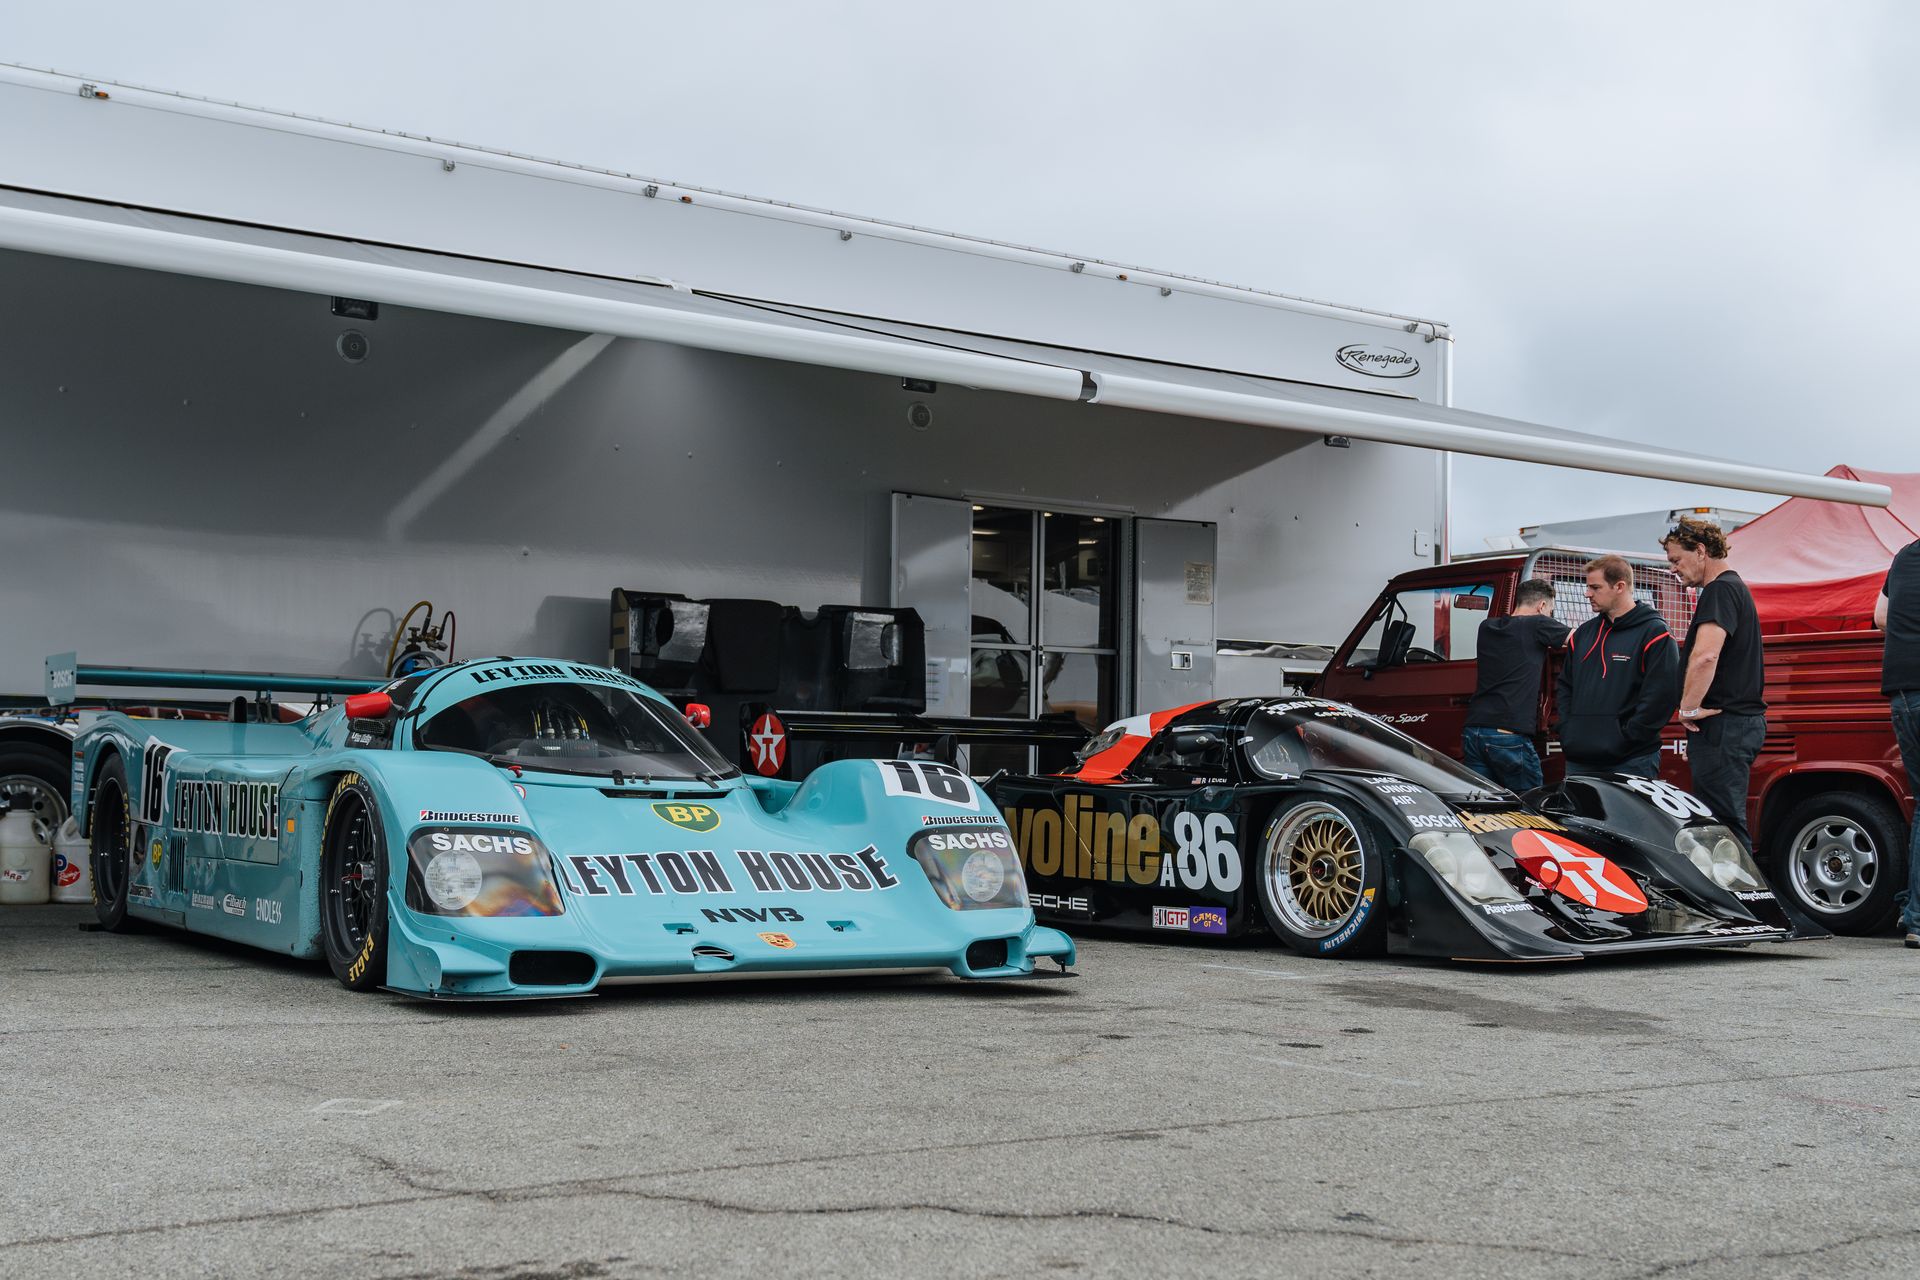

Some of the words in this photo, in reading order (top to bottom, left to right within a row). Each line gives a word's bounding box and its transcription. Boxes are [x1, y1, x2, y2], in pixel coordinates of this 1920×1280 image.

[1343, 349, 1413, 369] Renegade
[470, 664, 565, 684] LEYTON
[567, 664, 647, 692] HOUSE
[512, 674, 569, 682] PORSCHE
[1395, 713, 1429, 724] Sport
[143, 742, 173, 824] 16
[881, 760, 971, 804] 16
[1362, 776, 1401, 785] LAKE
[1376, 785, 1423, 794] UNION
[1392, 795, 1417, 806] AIR
[1626, 779, 1713, 819] 86
[172, 779, 223, 835] LEYTON
[227, 781, 280, 842] HOUSE
[420, 810, 520, 824] BRIDGESTONE
[664, 805, 711, 823] BP
[922, 814, 1000, 826] BRIDGESTONE
[1406, 814, 1463, 829] BOSCH
[431, 832, 533, 856] SACHS
[928, 832, 1009, 852] SACHS
[1173, 811, 1243, 893] 86
[556, 851, 735, 896] LEYTON
[735, 843, 900, 892] HOUSE
[1160, 853, 1176, 888] A
[1028, 893, 1088, 911] SCHE
[1733, 890, 1777, 902] Raychem
[255, 897, 282, 924] ENDLESS
[700, 907, 805, 923] NWB
[1482, 902, 1535, 915] Raychem
[1167, 911, 1188, 926] GTP
[1192, 912, 1223, 926] CAMEL
[1203, 920, 1211, 928] GT
[1324, 909, 1366, 950] MICHELIN
[348, 932, 375, 982] EAGLE
